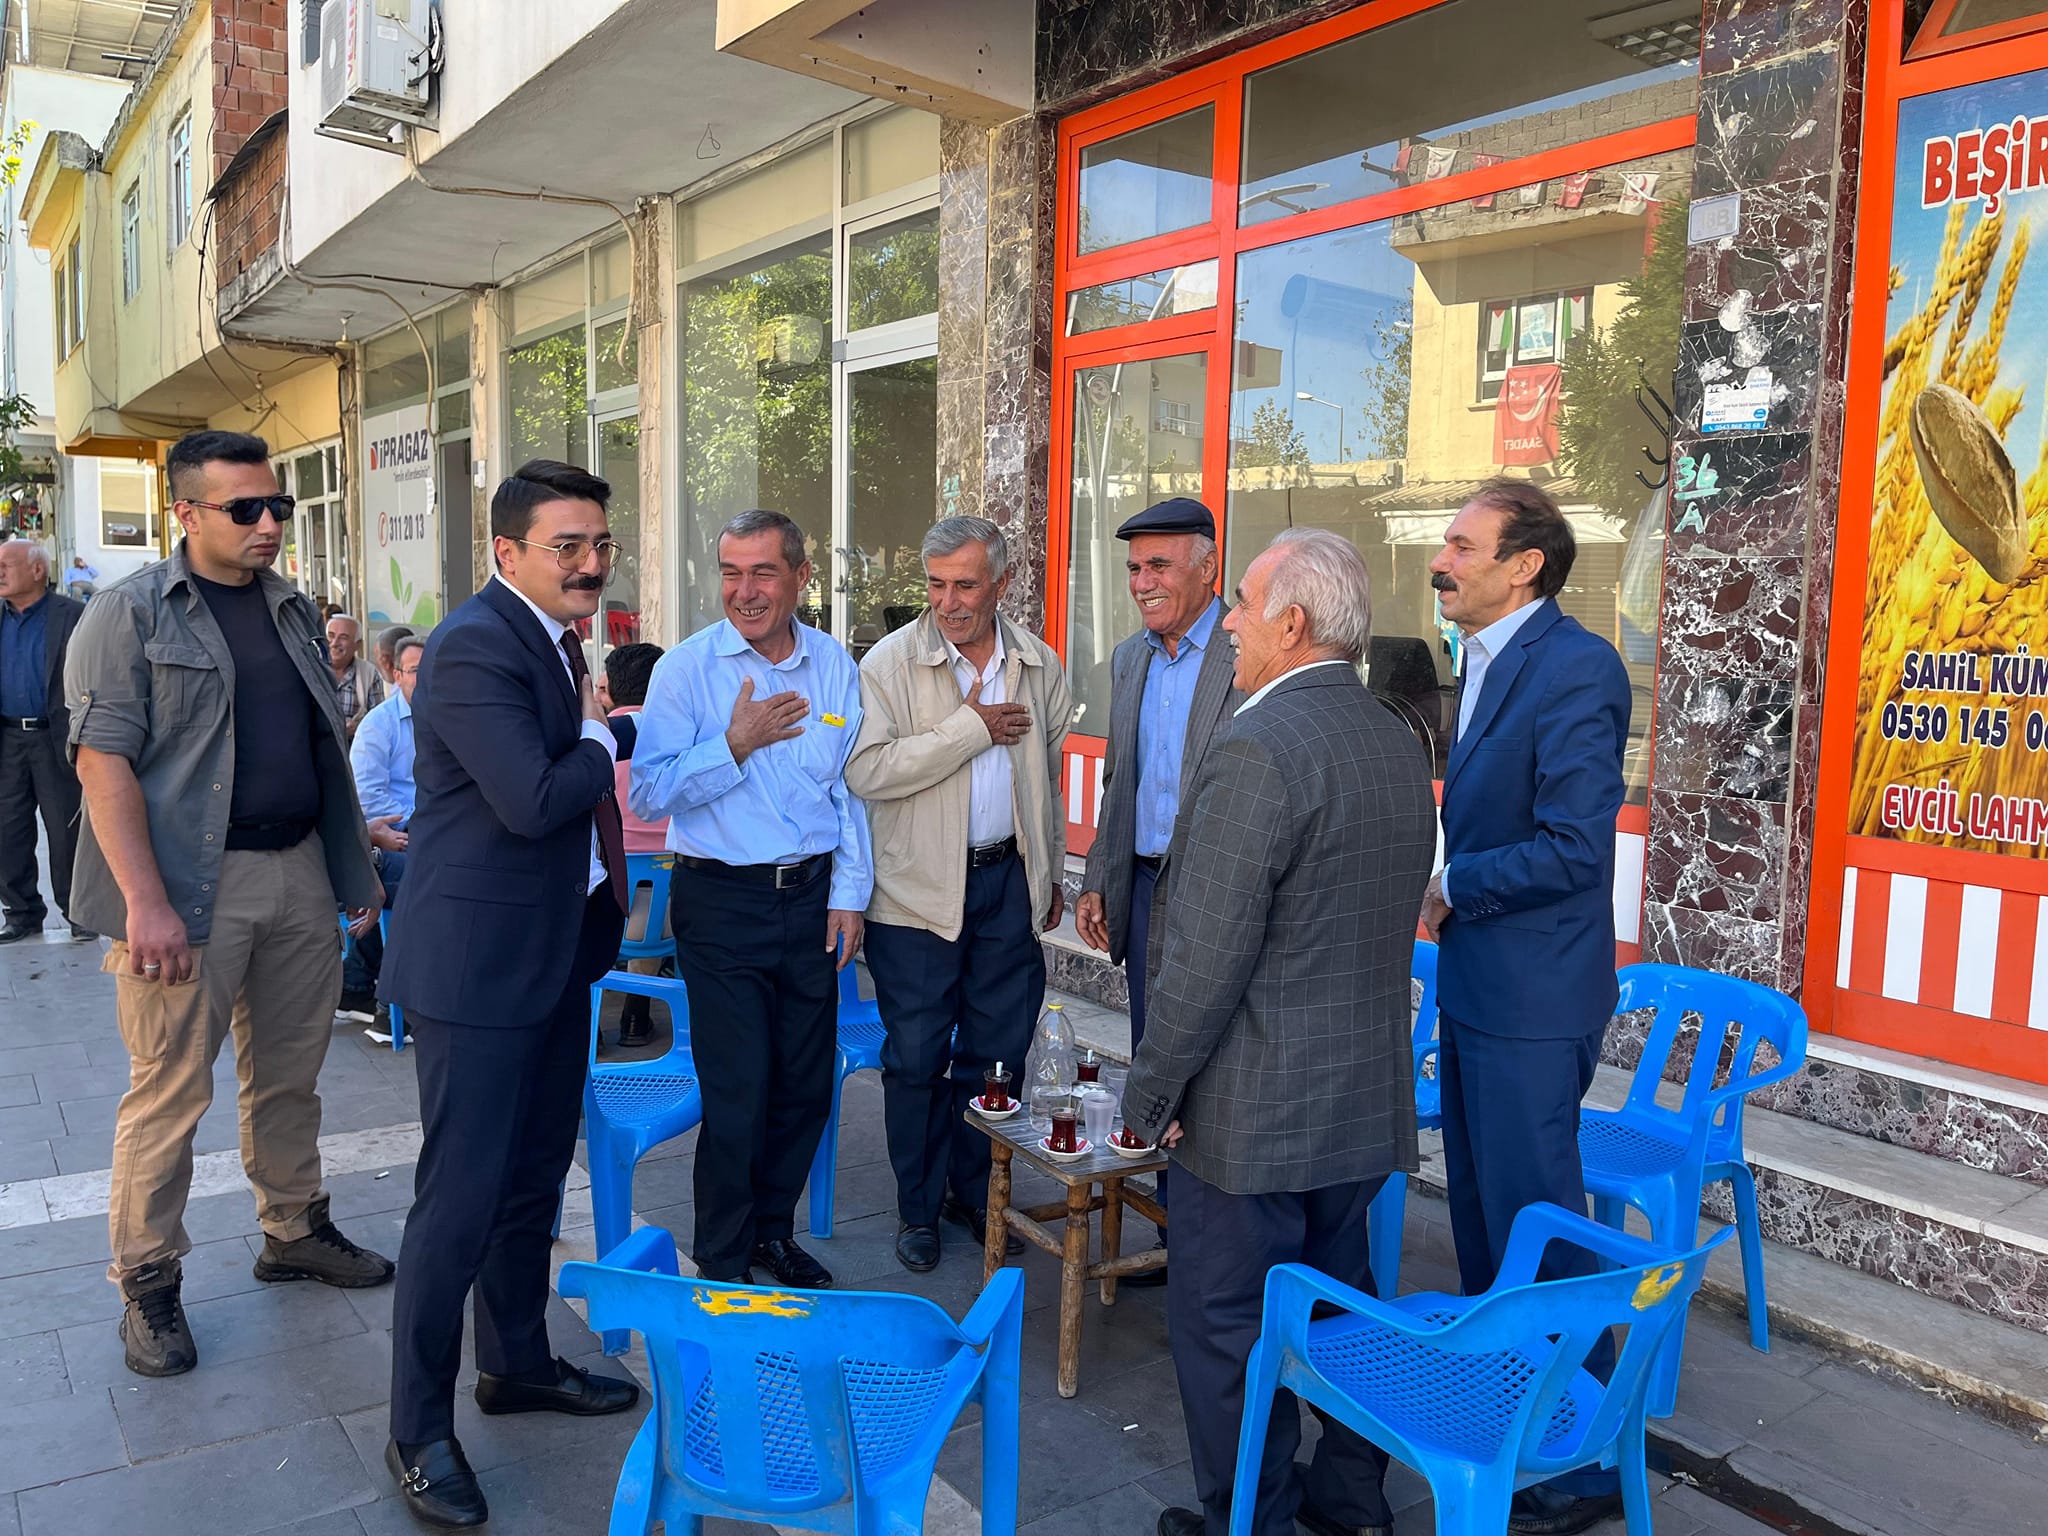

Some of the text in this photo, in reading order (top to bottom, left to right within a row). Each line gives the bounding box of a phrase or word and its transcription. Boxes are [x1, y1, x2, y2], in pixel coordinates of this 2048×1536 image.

[1676, 452, 1719, 490] 36
[389, 513, 425, 541] 311 20 13
[1673, 501, 1705, 534] A
[1883, 703, 2048, 751] 0530 145 0
